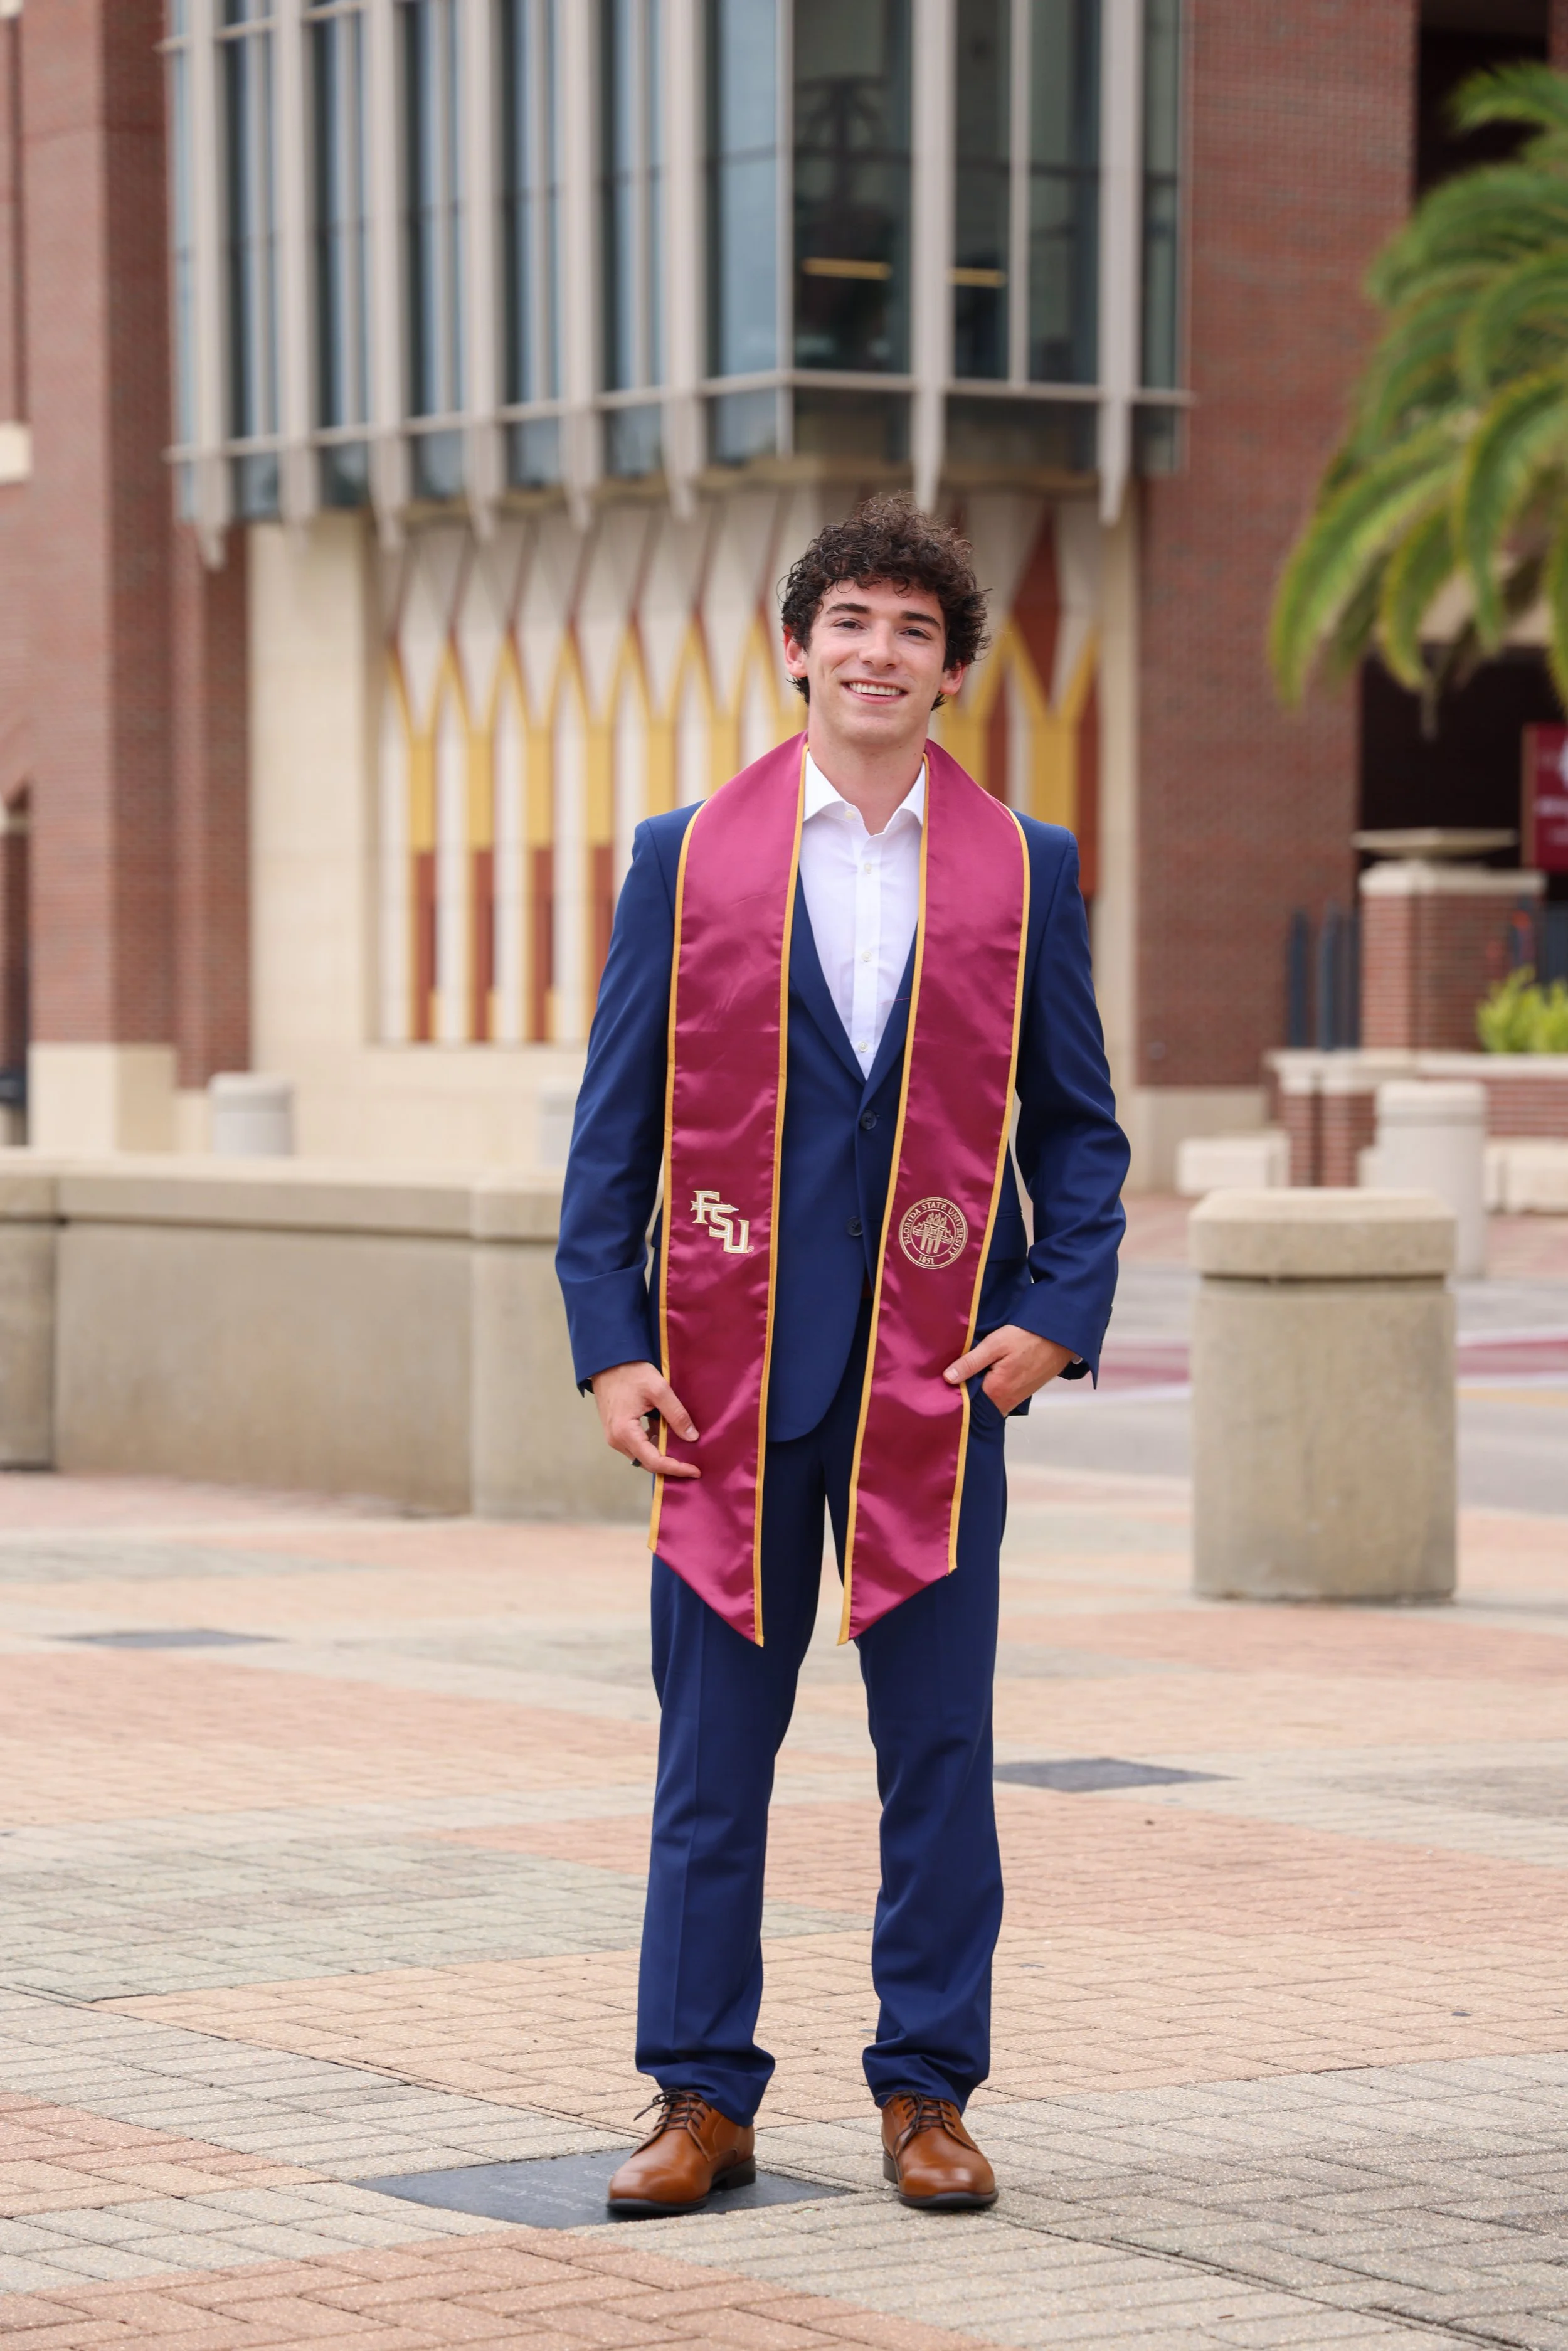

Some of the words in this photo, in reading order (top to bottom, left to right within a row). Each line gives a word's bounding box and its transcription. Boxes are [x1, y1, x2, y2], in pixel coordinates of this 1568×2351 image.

[690, 1191, 749, 1253] FSU
[903, 1209, 921, 1244] FLORIDA
[922, 1202, 946, 1210] STATE
[948, 1208, 963, 1257] UNIVERSITY
[918, 1255, 935, 1264] 1851
